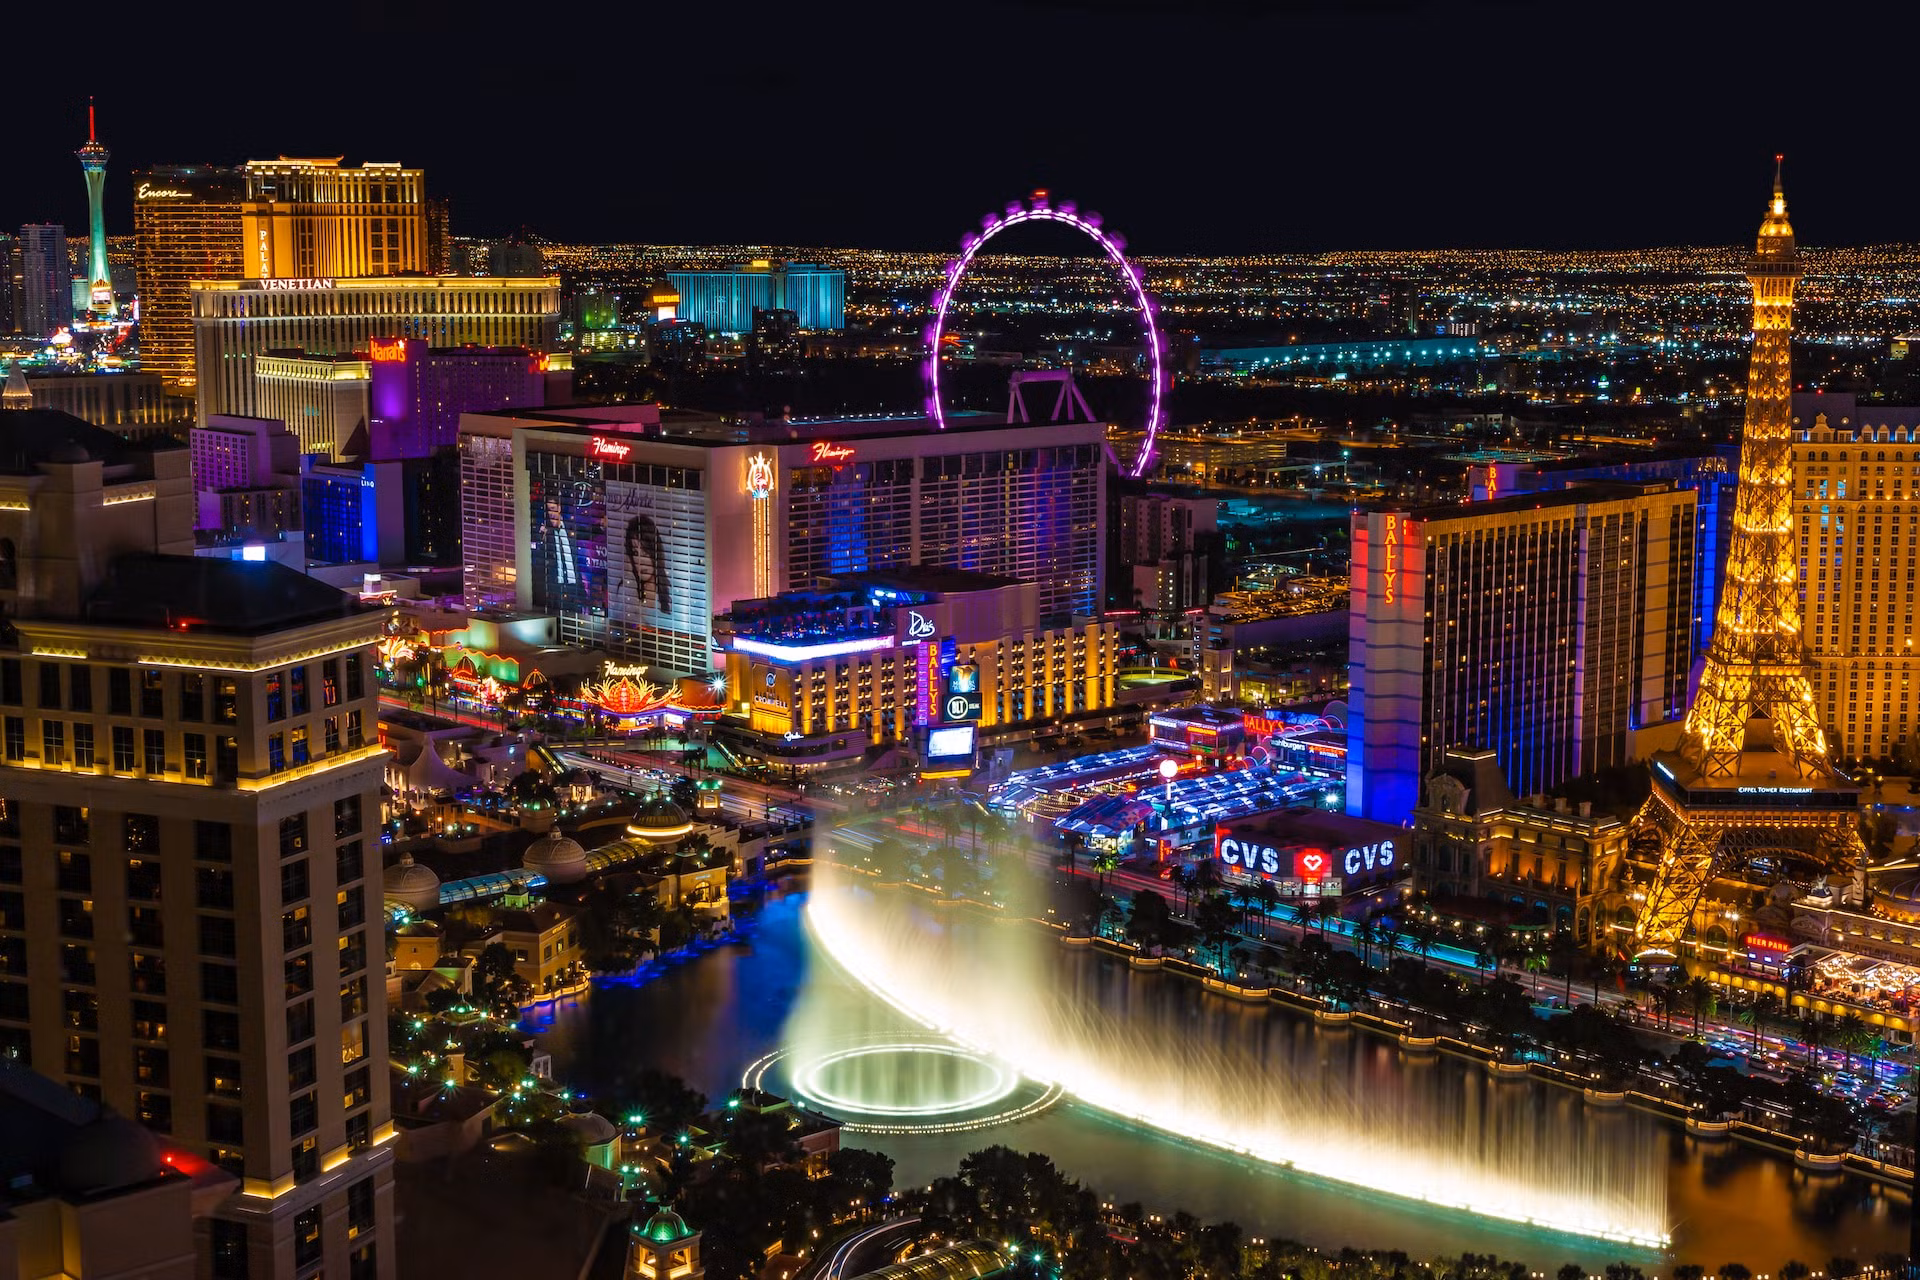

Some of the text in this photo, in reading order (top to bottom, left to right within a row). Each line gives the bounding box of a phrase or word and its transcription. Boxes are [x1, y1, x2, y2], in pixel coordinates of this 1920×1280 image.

[138, 183, 192, 199] Encore
[260, 278, 332, 290] VENETIAN
[592, 437, 630, 459] Flamingo
[1383, 515, 1398, 604] BALLYS
[604, 661, 648, 679] Flamingo
[928, 644, 939, 716] BALLYS
[1243, 714, 1285, 734] BALLY'S
[1221, 838, 1279, 874] CVS
[1344, 840, 1394, 875] CVS
[1747, 936, 1790, 952] BEER PARK
